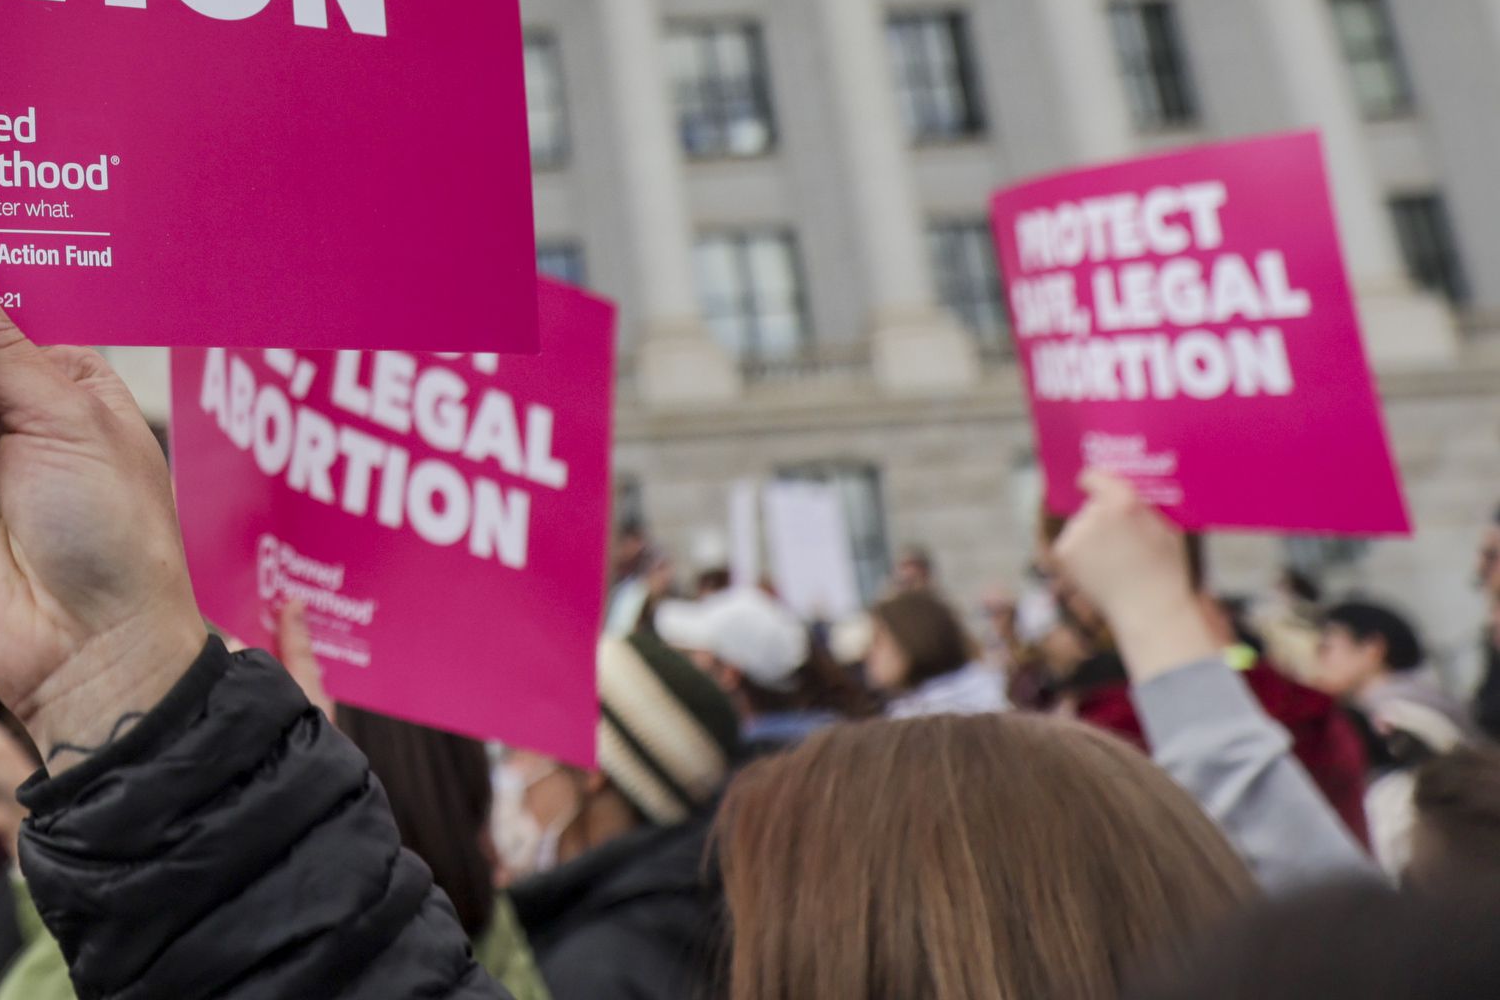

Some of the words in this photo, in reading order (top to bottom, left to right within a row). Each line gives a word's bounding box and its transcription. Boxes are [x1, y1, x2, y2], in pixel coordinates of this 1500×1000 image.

[24, 199, 74, 219] what.
[65, 245, 112, 267] Fund
[1091, 250, 1312, 330] LEGAL
[199, 347, 531, 570] ABORTION
[331, 349, 569, 489] LEGAL
